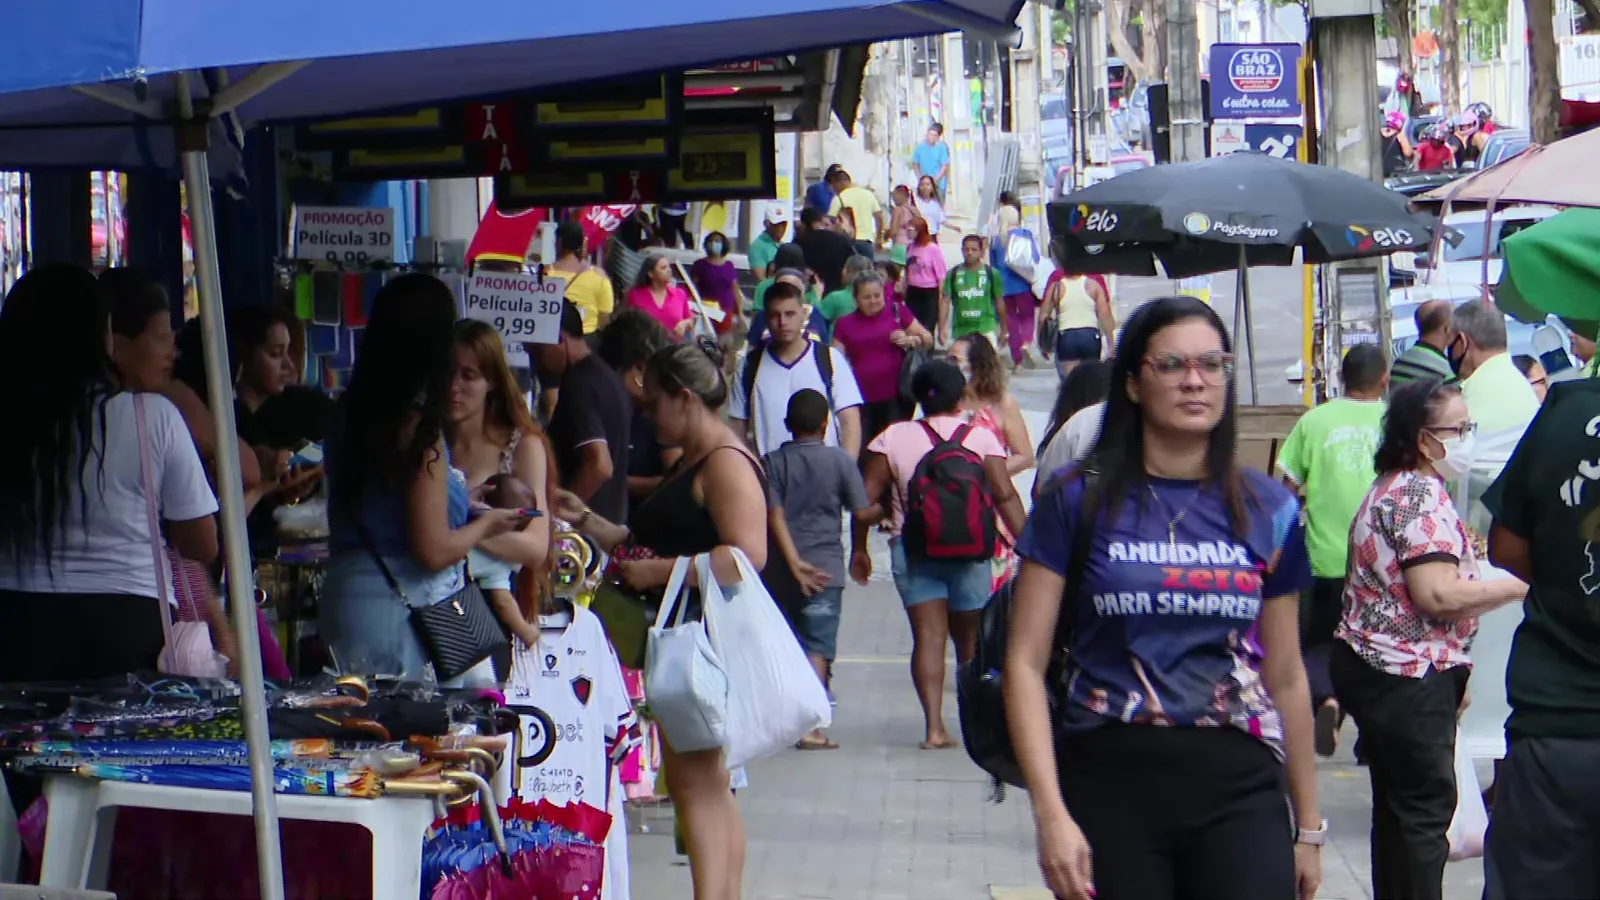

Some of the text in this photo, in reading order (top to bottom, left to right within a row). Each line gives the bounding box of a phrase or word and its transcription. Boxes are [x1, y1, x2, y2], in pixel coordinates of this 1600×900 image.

[1241, 52, 1270, 65] SÃO
[1235, 65, 1277, 76] BRAZ
[303, 210, 385, 227] PROMOÇÃO
[1086, 208, 1119, 233] elo
[299, 230, 392, 246] Película 3D
[1213, 221, 1279, 238] PagSeguro
[1372, 227, 1413, 247] elo
[475, 276, 558, 295] PROMOÇÃO
[469, 294, 561, 315] Película 3D
[494, 316, 536, 337] 9,99
[1108, 541, 1251, 566] ANUIDADE
[1162, 567, 1257, 594] zero
[1092, 592, 1151, 616] PARA
